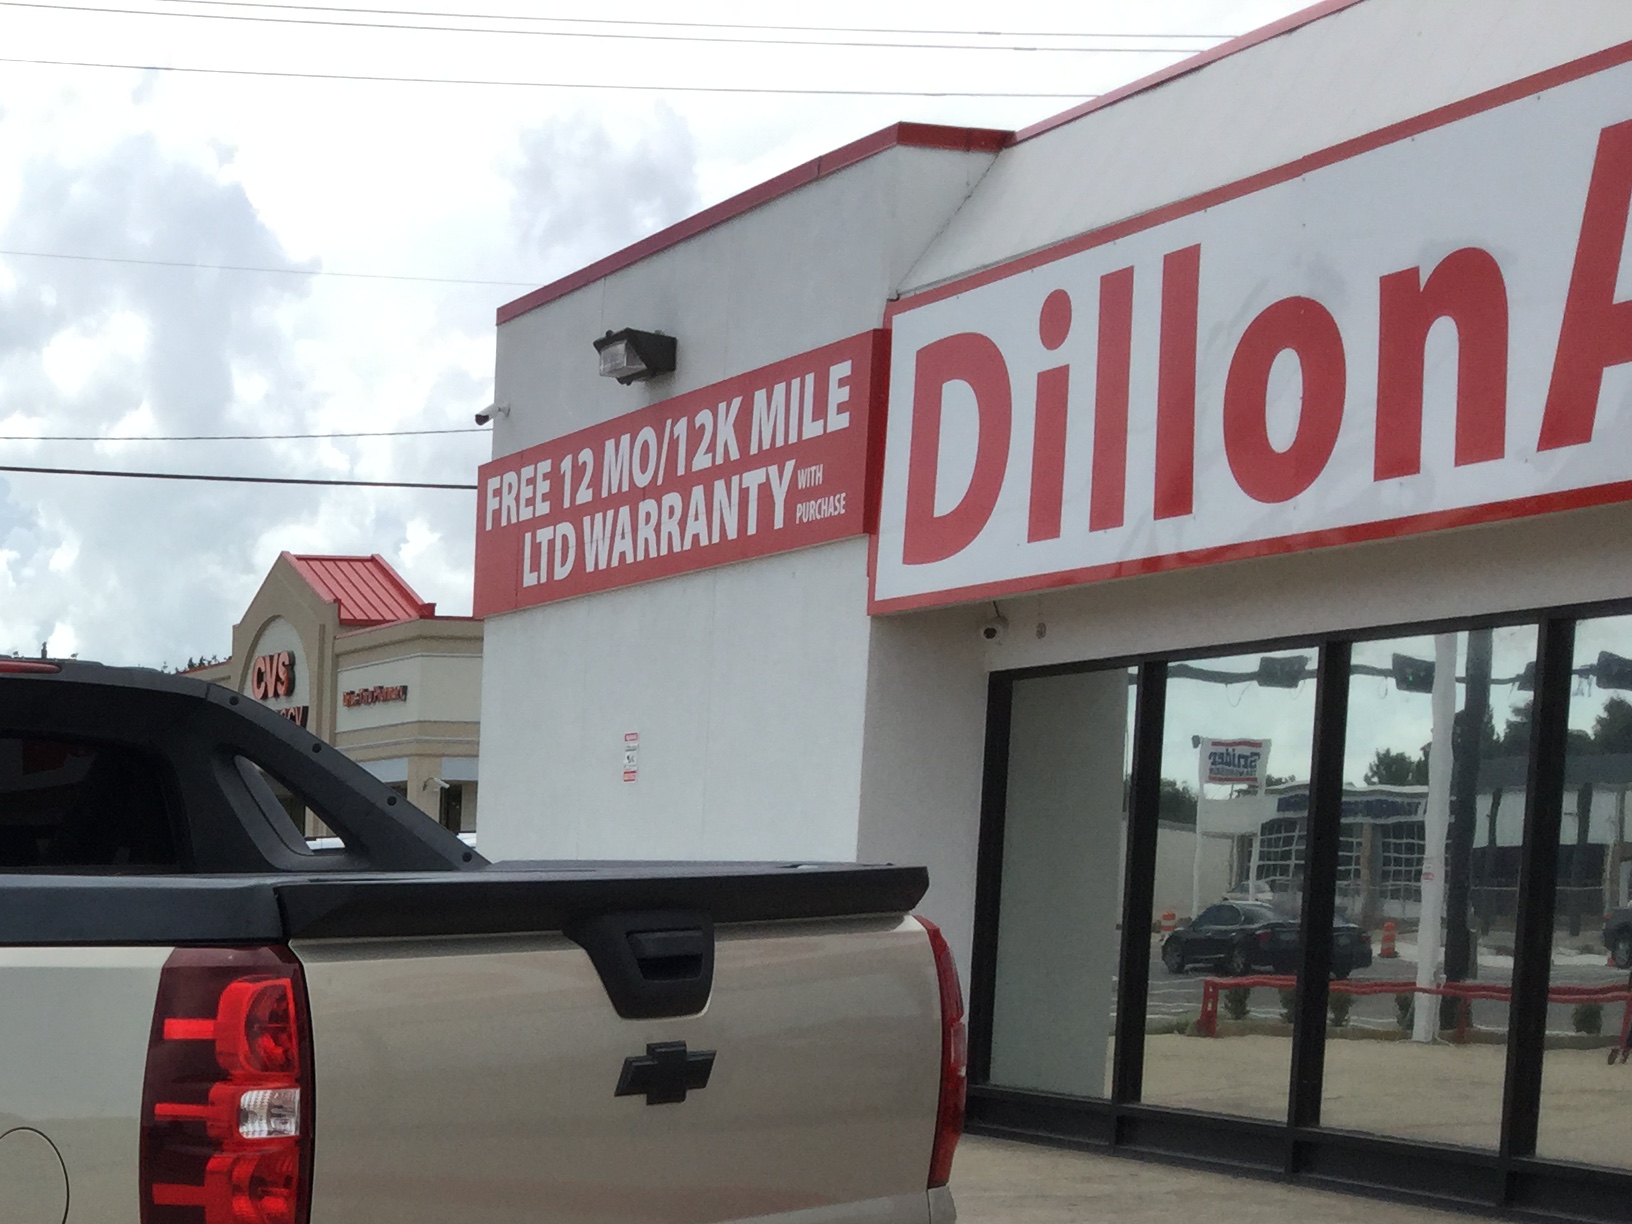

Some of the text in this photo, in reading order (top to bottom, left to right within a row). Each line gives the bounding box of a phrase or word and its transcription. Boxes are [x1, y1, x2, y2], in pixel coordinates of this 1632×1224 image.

[485, 359, 852, 531] FREE 12 MO/12K MILE
[797, 463, 824, 490] WITH
[522, 458, 796, 588] LTD WARRANTY
[795, 492, 847, 525] PURCHASE
[252, 651, 296, 700] CVS
